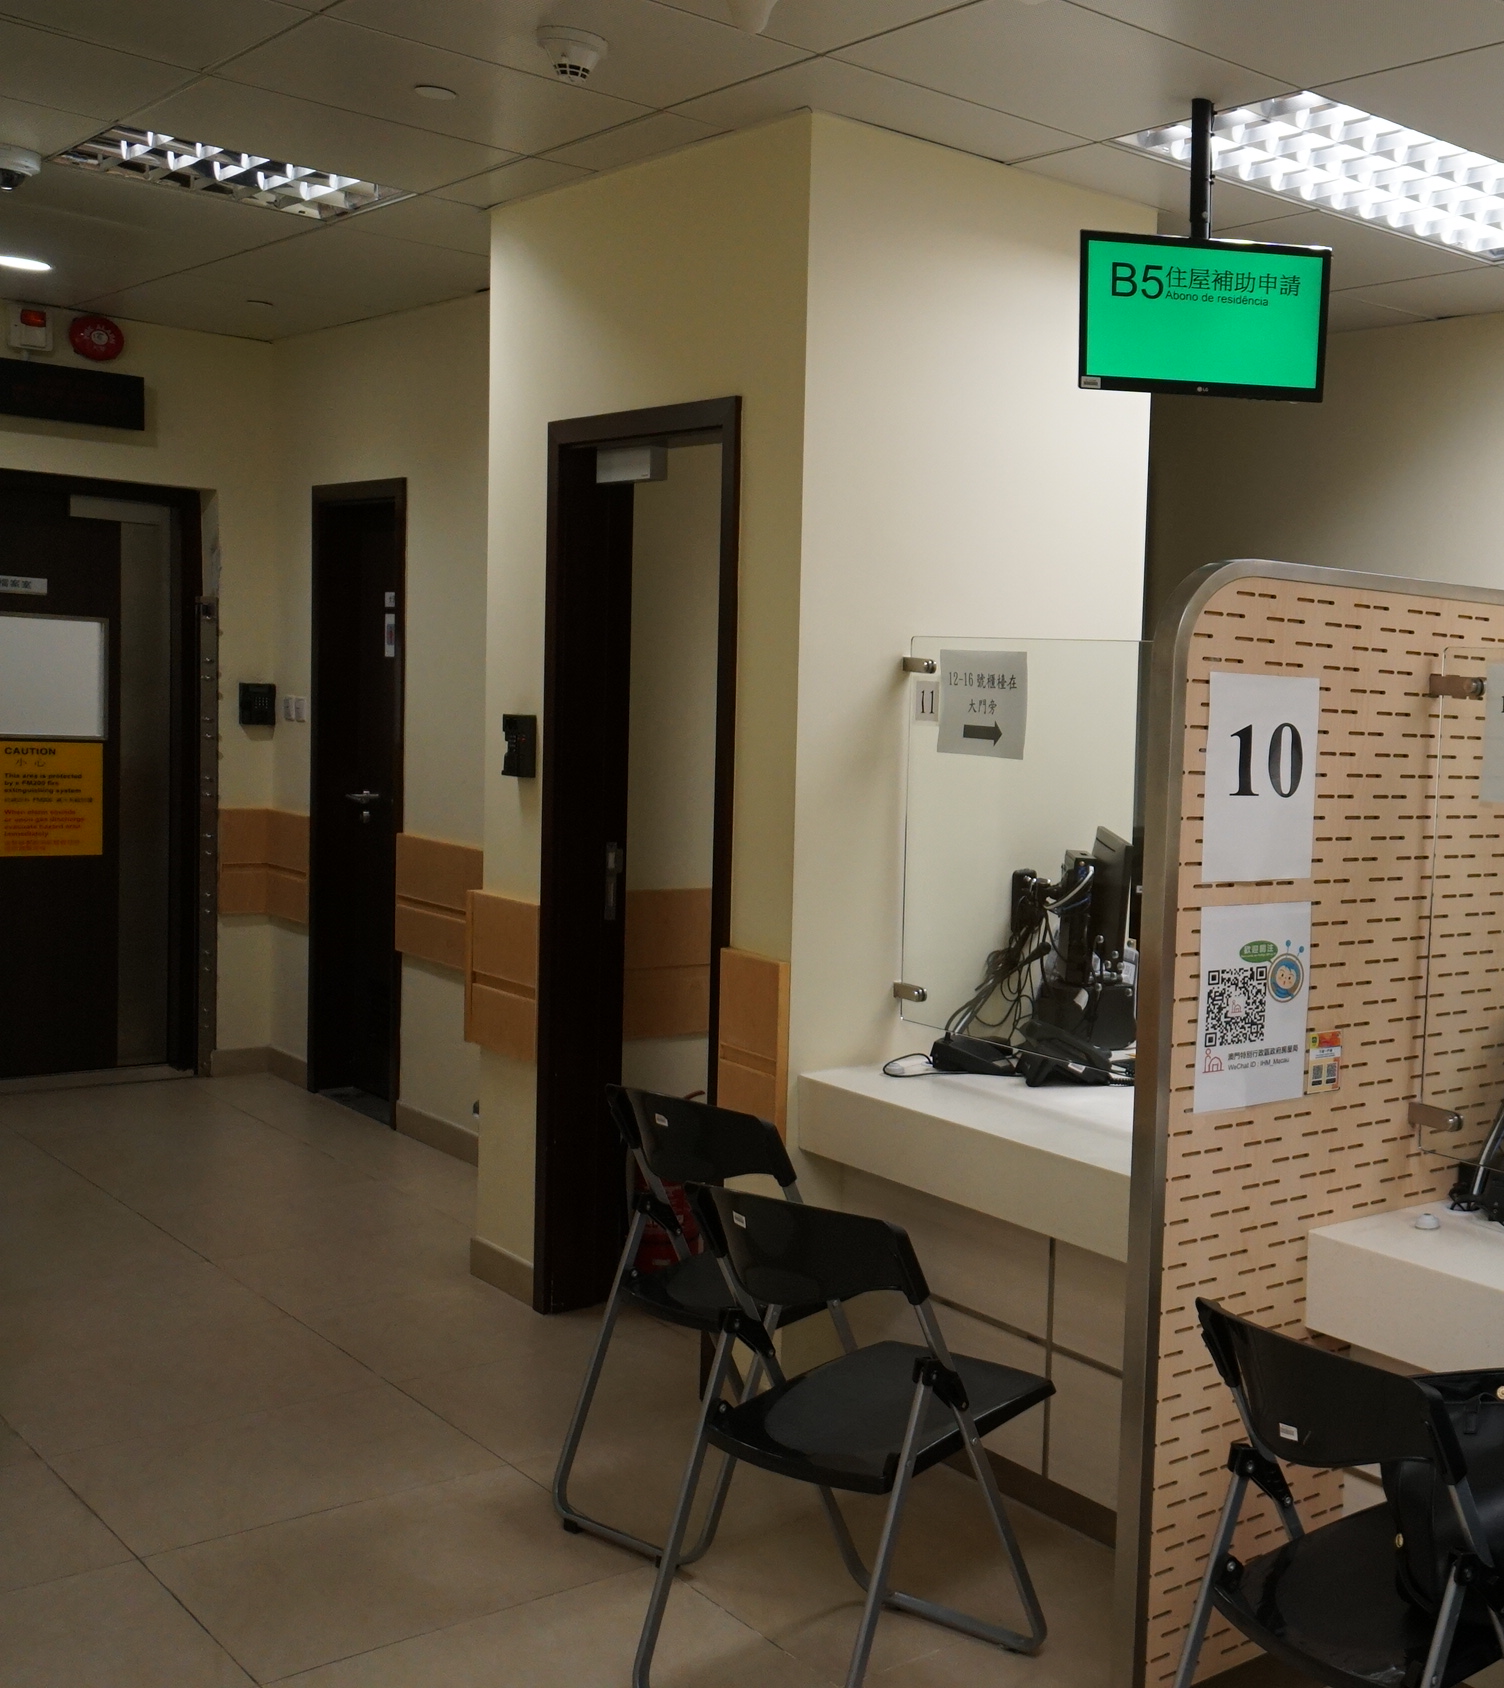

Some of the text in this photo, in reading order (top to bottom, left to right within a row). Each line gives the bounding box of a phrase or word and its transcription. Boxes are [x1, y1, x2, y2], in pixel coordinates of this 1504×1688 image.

[1111, 262, 1163, 299] B5
[1166, 266, 1300, 297] 住屋補助申請
[1165, 290, 1268, 306] Abono de residência
[948, 671, 974, 687] 12-16
[967, 699, 998, 715] 大門旁
[4, 747, 56, 756] CAUTION
[1229, 722, 1304, 799] 10
